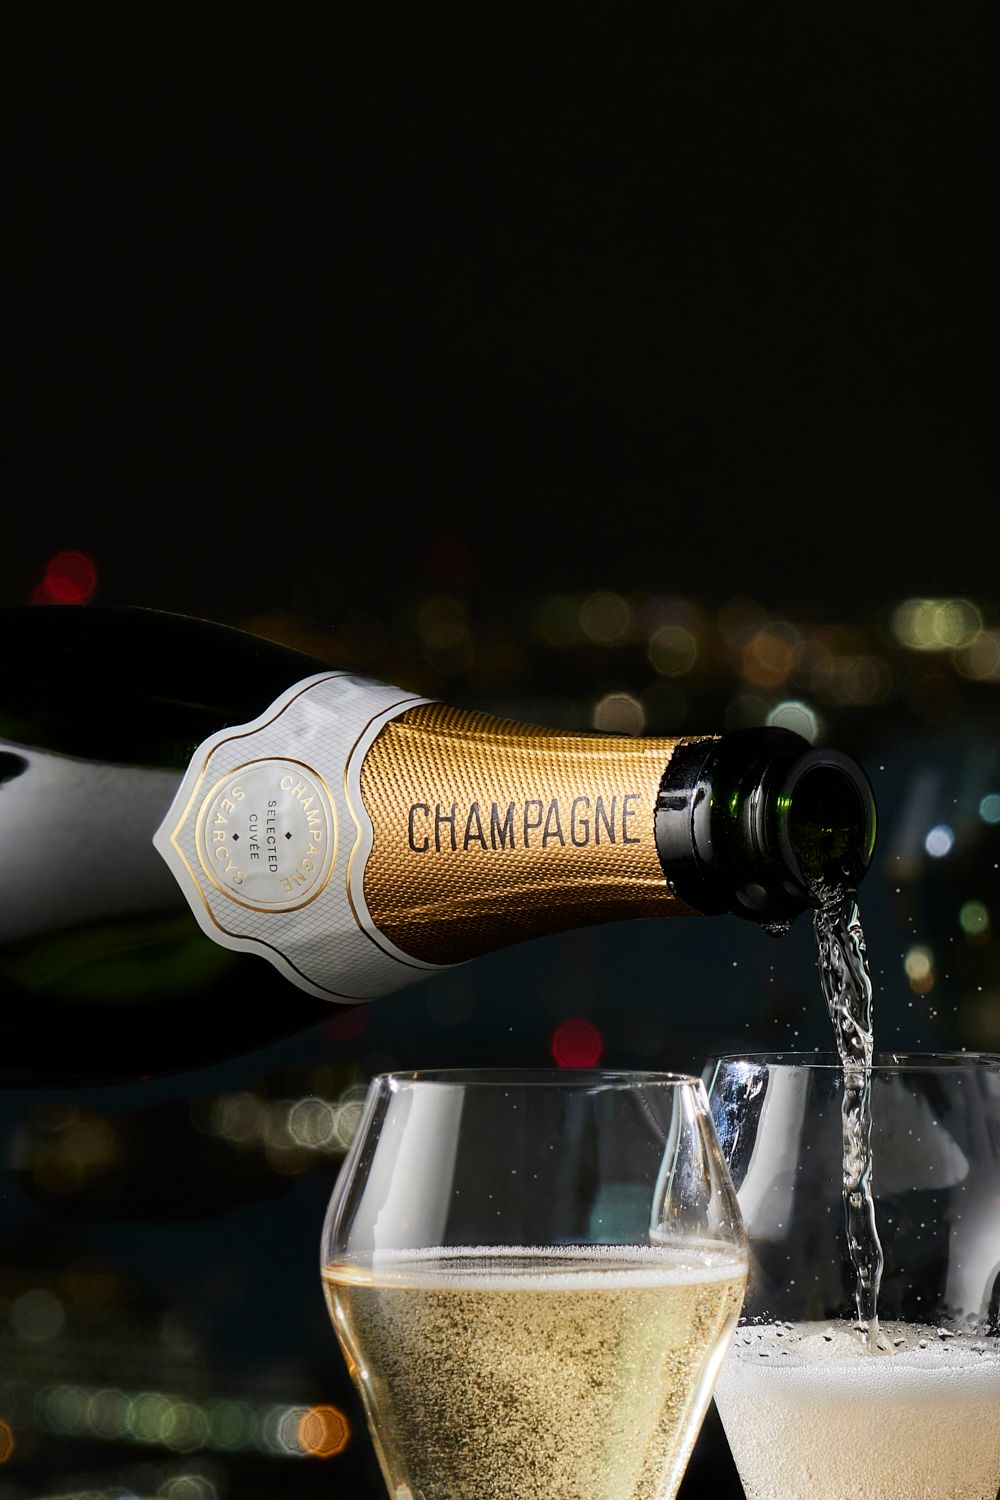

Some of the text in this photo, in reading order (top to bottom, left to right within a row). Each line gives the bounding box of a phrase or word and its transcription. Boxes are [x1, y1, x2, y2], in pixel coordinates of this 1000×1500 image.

[212, 786, 245, 886] SEARCYS
[249, 813, 260, 860] CUVÉE
[266, 800, 278, 873] SELECTED
[280, 776, 321, 893] CHAMPAGNE
[408, 793, 641, 853] CHAMPAGNE
